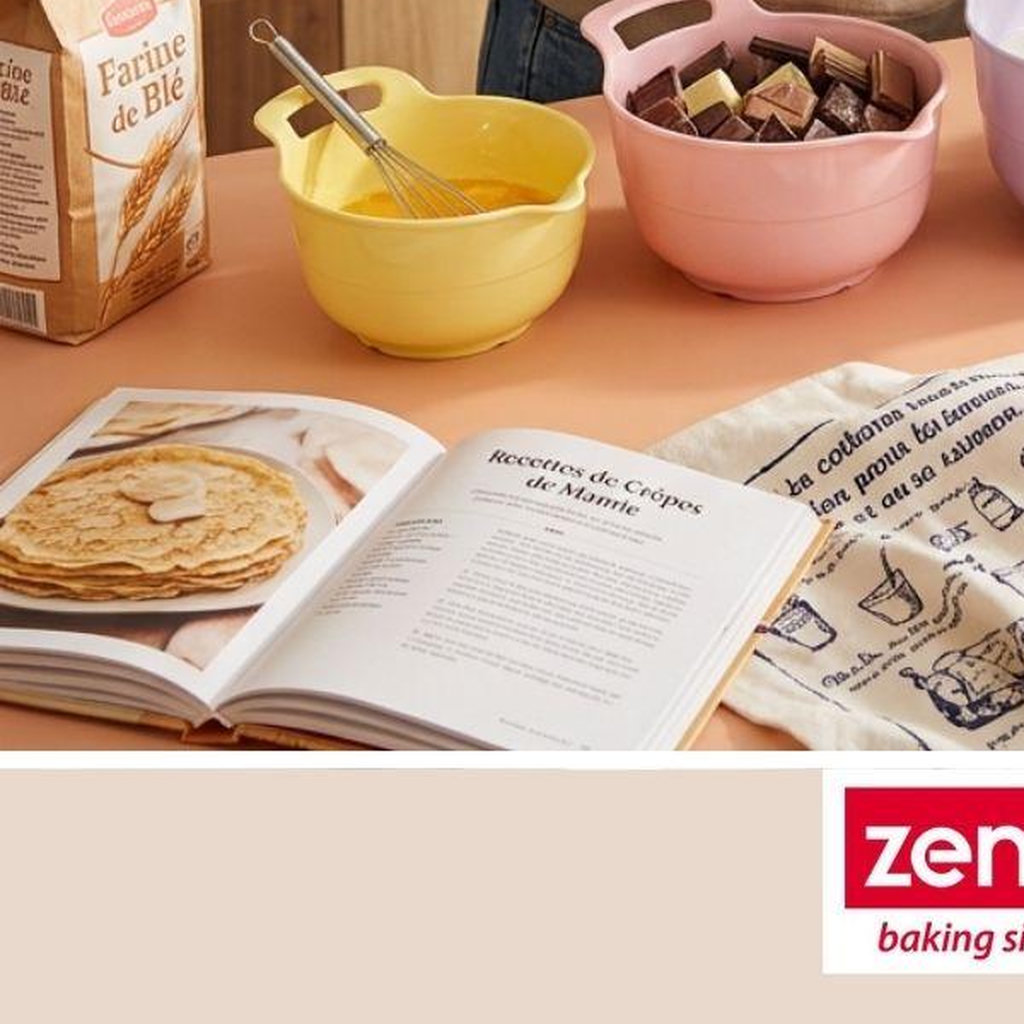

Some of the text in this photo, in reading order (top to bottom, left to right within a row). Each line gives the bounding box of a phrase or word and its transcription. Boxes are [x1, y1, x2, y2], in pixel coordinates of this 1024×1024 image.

[97, 33, 186, 97] Farine
[112, 67, 184, 133] de Blé
[526, 475, 557, 492] de
[589, 470, 619, 488] de
